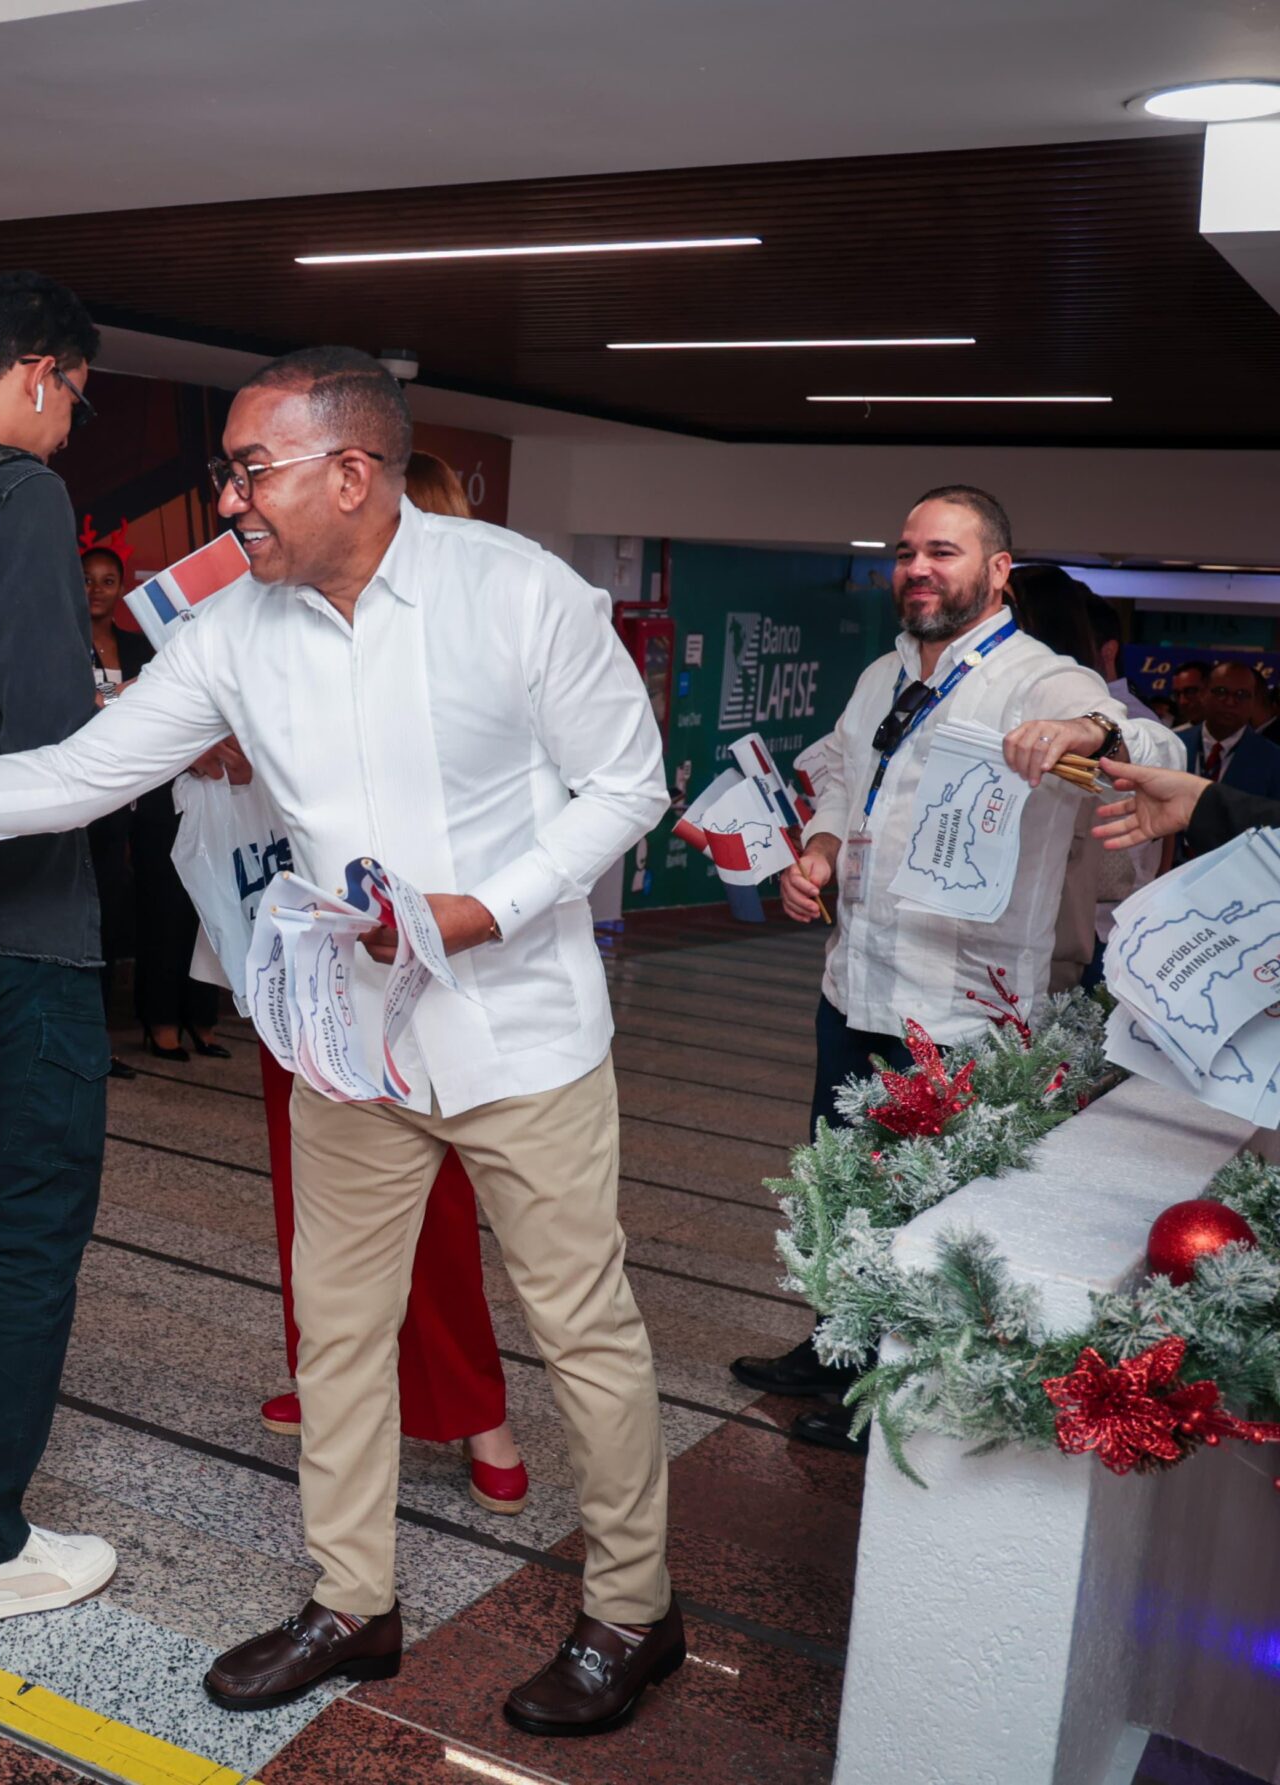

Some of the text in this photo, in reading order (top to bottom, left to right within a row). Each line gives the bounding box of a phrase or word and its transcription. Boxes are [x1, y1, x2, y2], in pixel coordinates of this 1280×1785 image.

[761, 617, 801, 654] Banco
[755, 661, 819, 722] LAFISE
[981, 787, 1006, 834] CPEP
[932, 812, 950, 866] REPÚBLICA
[943, 808, 963, 869] DOMINICANA
[1155, 926, 1217, 982] REPÚBLICA
[1168, 933, 1241, 993] DOMINICANA
[1253, 954, 1280, 983] CP
